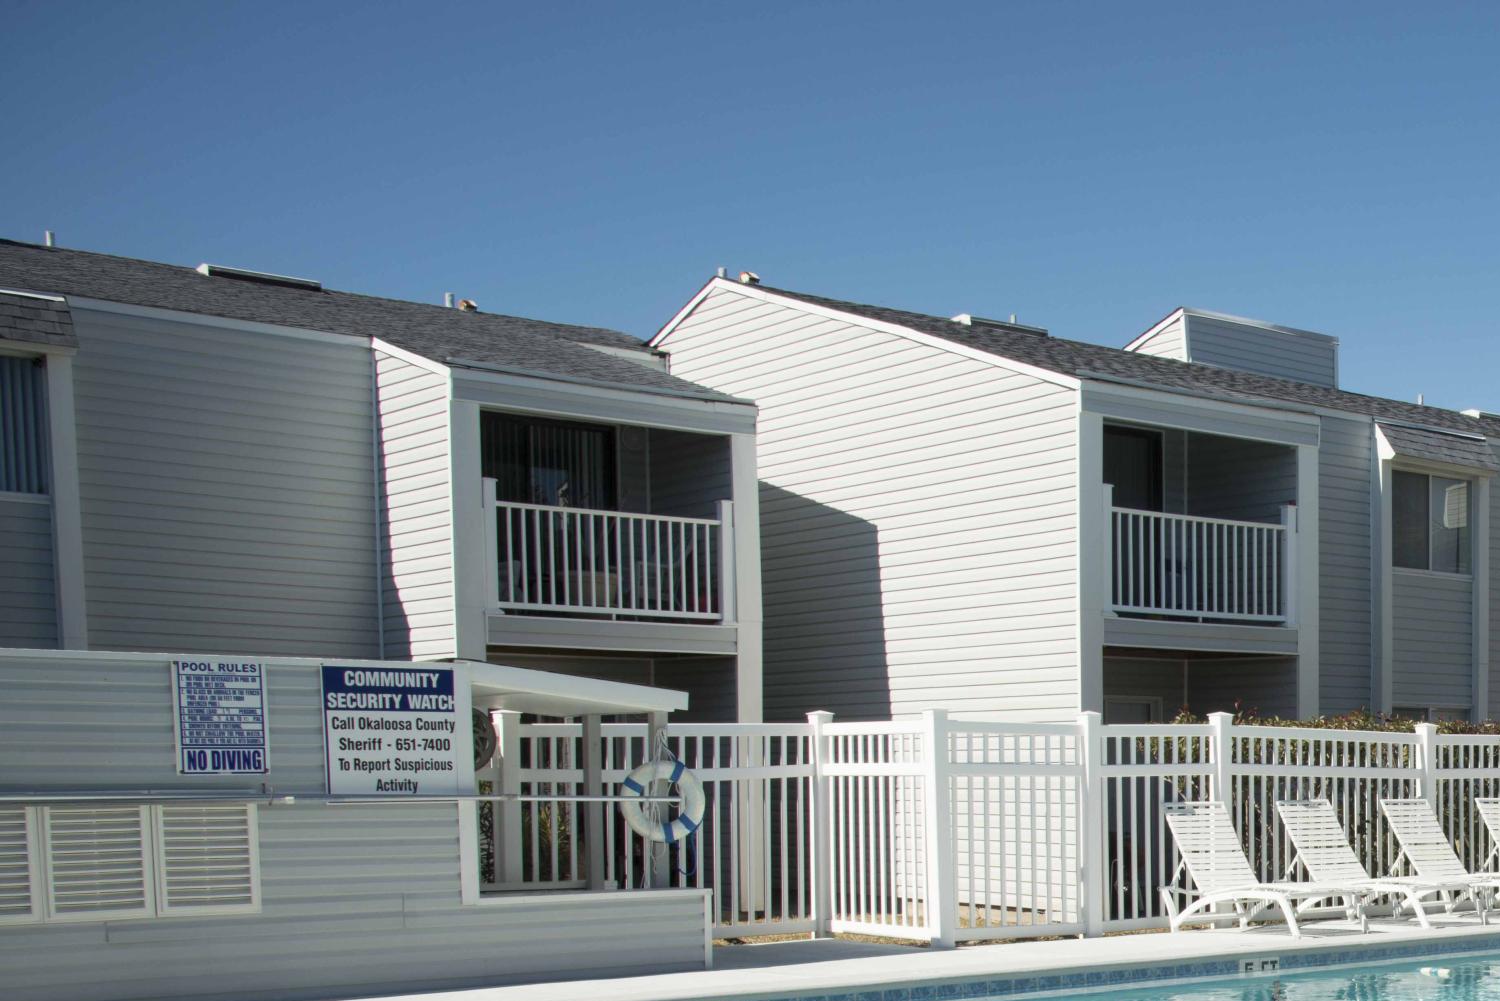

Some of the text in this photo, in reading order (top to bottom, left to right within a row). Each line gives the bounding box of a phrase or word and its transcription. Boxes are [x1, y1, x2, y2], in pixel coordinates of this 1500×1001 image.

[181, 662, 257, 673] POOL RULES
[344, 670, 440, 688] COMMUNITY
[327, 692, 402, 709] SECURITY
[331, 716, 455, 733] Call Okaloosa County
[339, 737, 383, 751] Sheriff
[395, 738, 450, 751] 651-7400
[186, 750, 262, 771] NO DIVING
[338, 758, 453, 773] To Report Suspicious
[376, 778, 418, 794] Activity
